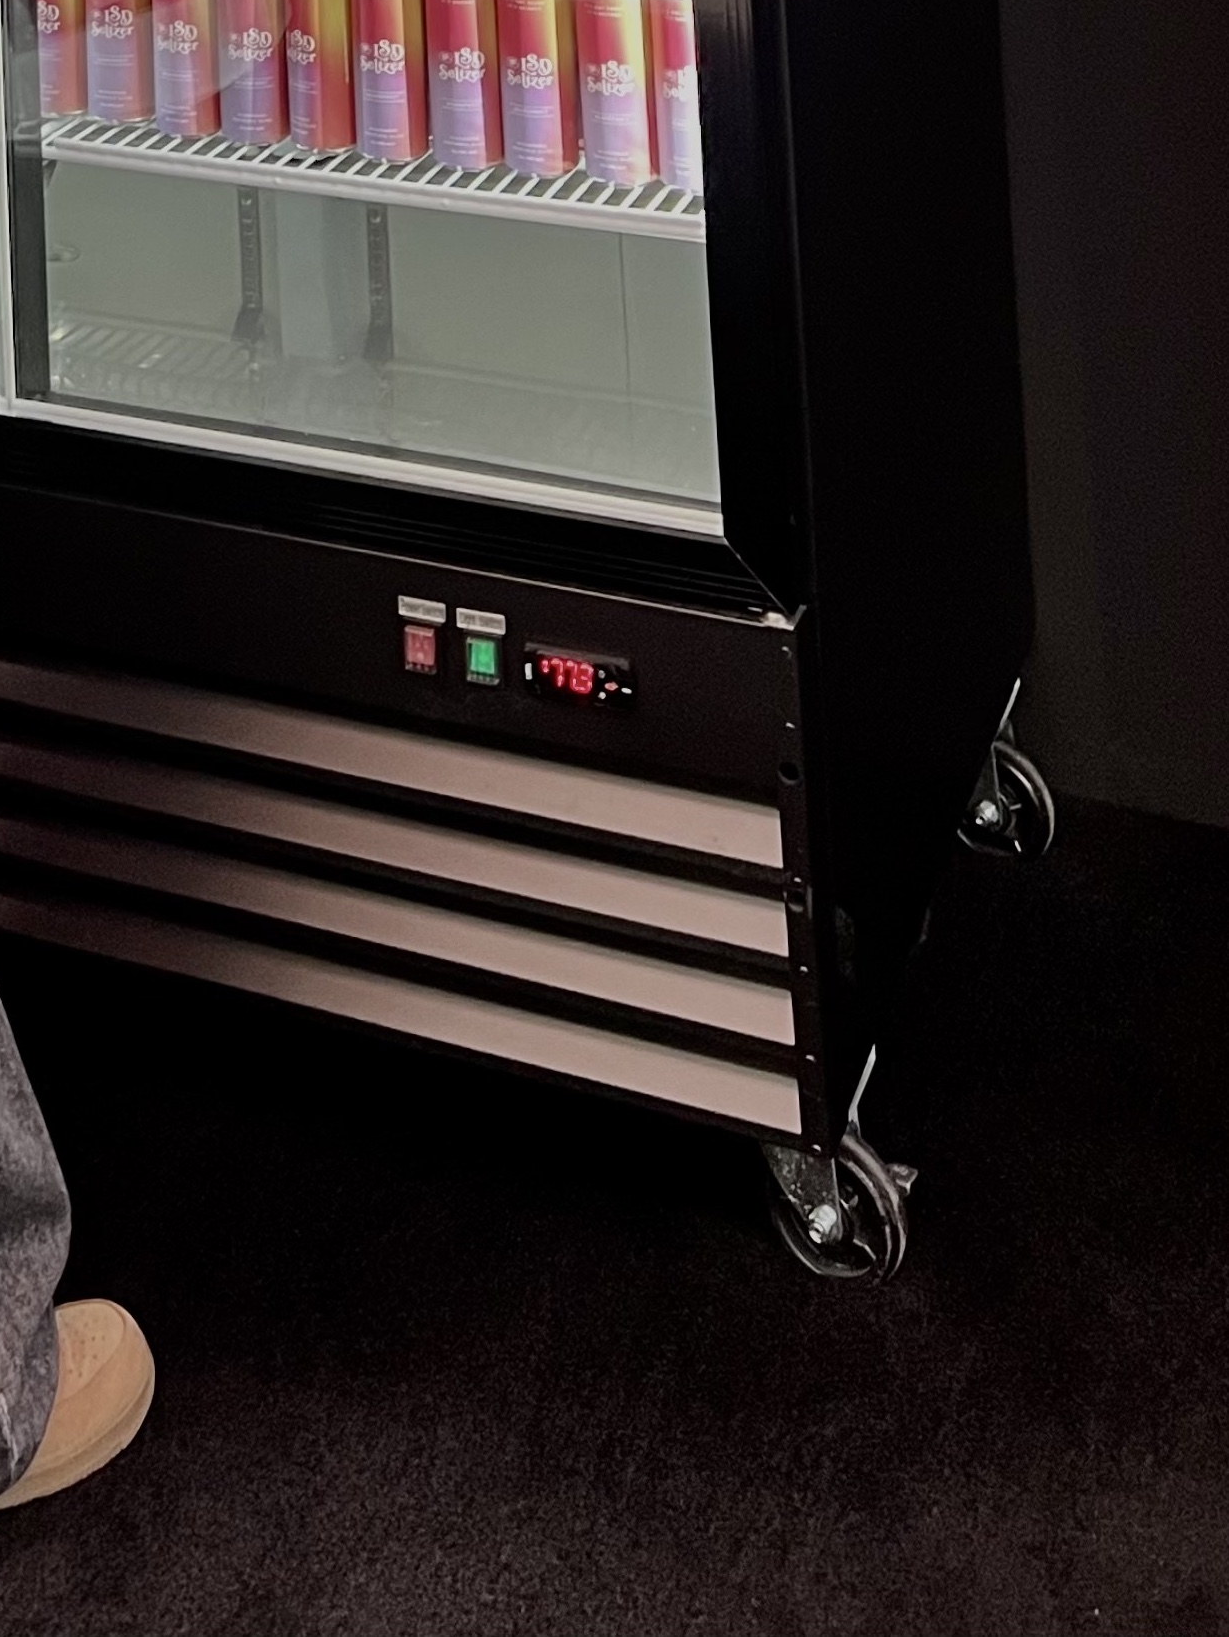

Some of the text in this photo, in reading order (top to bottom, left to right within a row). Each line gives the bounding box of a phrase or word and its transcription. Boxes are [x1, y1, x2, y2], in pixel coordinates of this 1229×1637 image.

[105, 5, 133, 27] LSD
[170, 20, 197, 43] LSD
[243, 28, 271, 49] LSD
[373, 39, 405, 61] LSD
[454, 47, 484, 68] LSD
[522, 53, 553, 76] LSD
